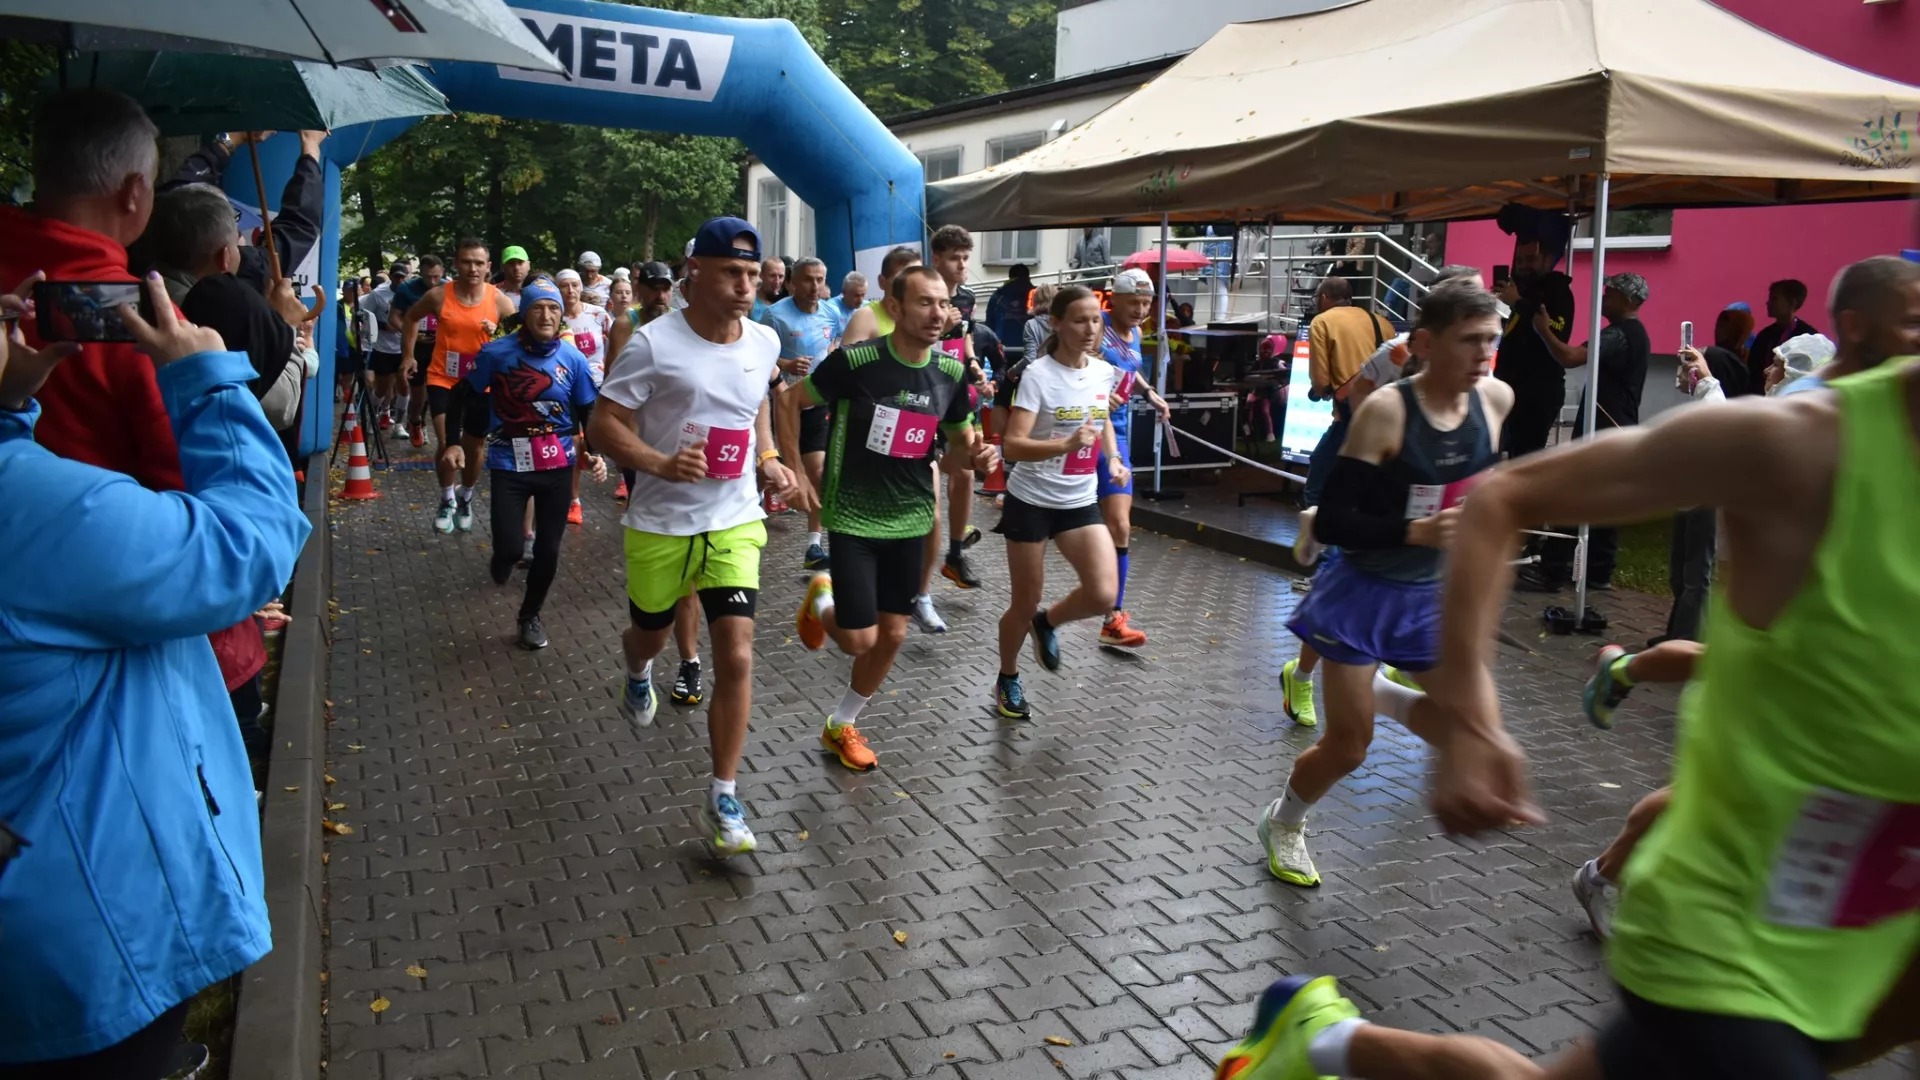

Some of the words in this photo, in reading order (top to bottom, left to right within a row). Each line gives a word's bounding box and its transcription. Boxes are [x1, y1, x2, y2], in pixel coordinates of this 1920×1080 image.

[579, 339, 591, 349] 12
[905, 427, 926, 444] 68
[541, 445, 559, 459] 59
[717, 443, 741, 462] 52
[1077, 446, 1093, 460] 61
